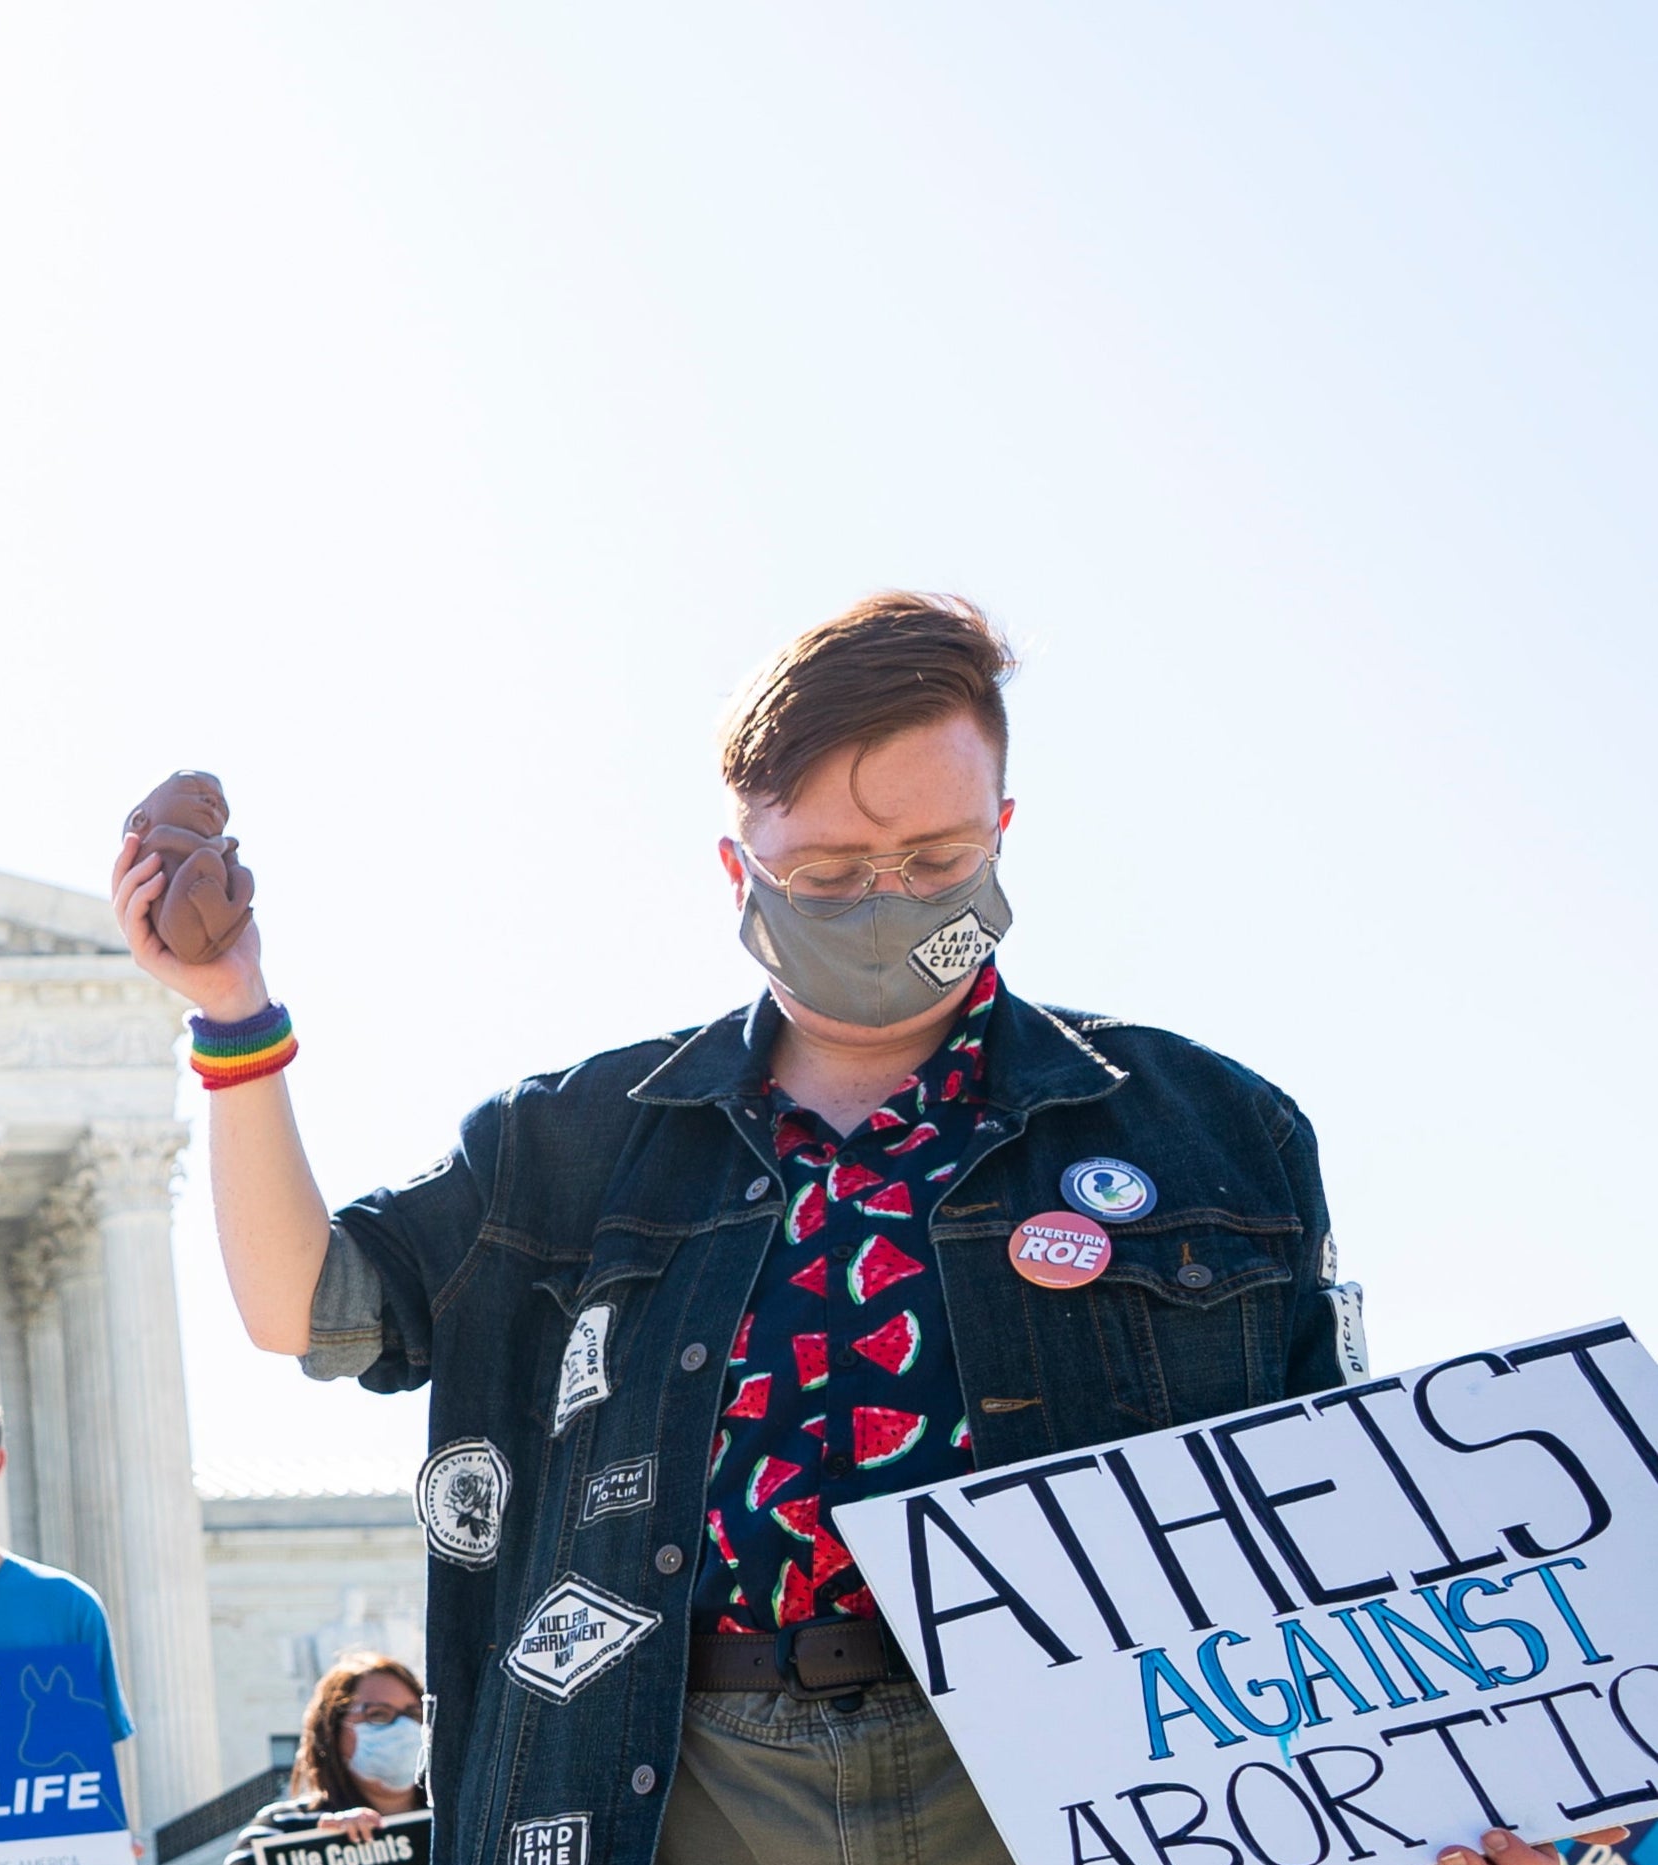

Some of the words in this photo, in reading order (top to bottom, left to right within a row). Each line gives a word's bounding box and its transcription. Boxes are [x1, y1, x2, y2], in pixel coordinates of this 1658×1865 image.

[929, 956, 977, 968] CELLS
[1021, 1224, 1106, 1247] OVERTURN
[1018, 1236, 1103, 1271] ROE
[1343, 1315, 1364, 1373] DITCH
[901, 1322, 1658, 1696] ATHEIST
[1133, 1556, 1614, 1762] AGAINST
[523, 1826, 573, 1849] END
